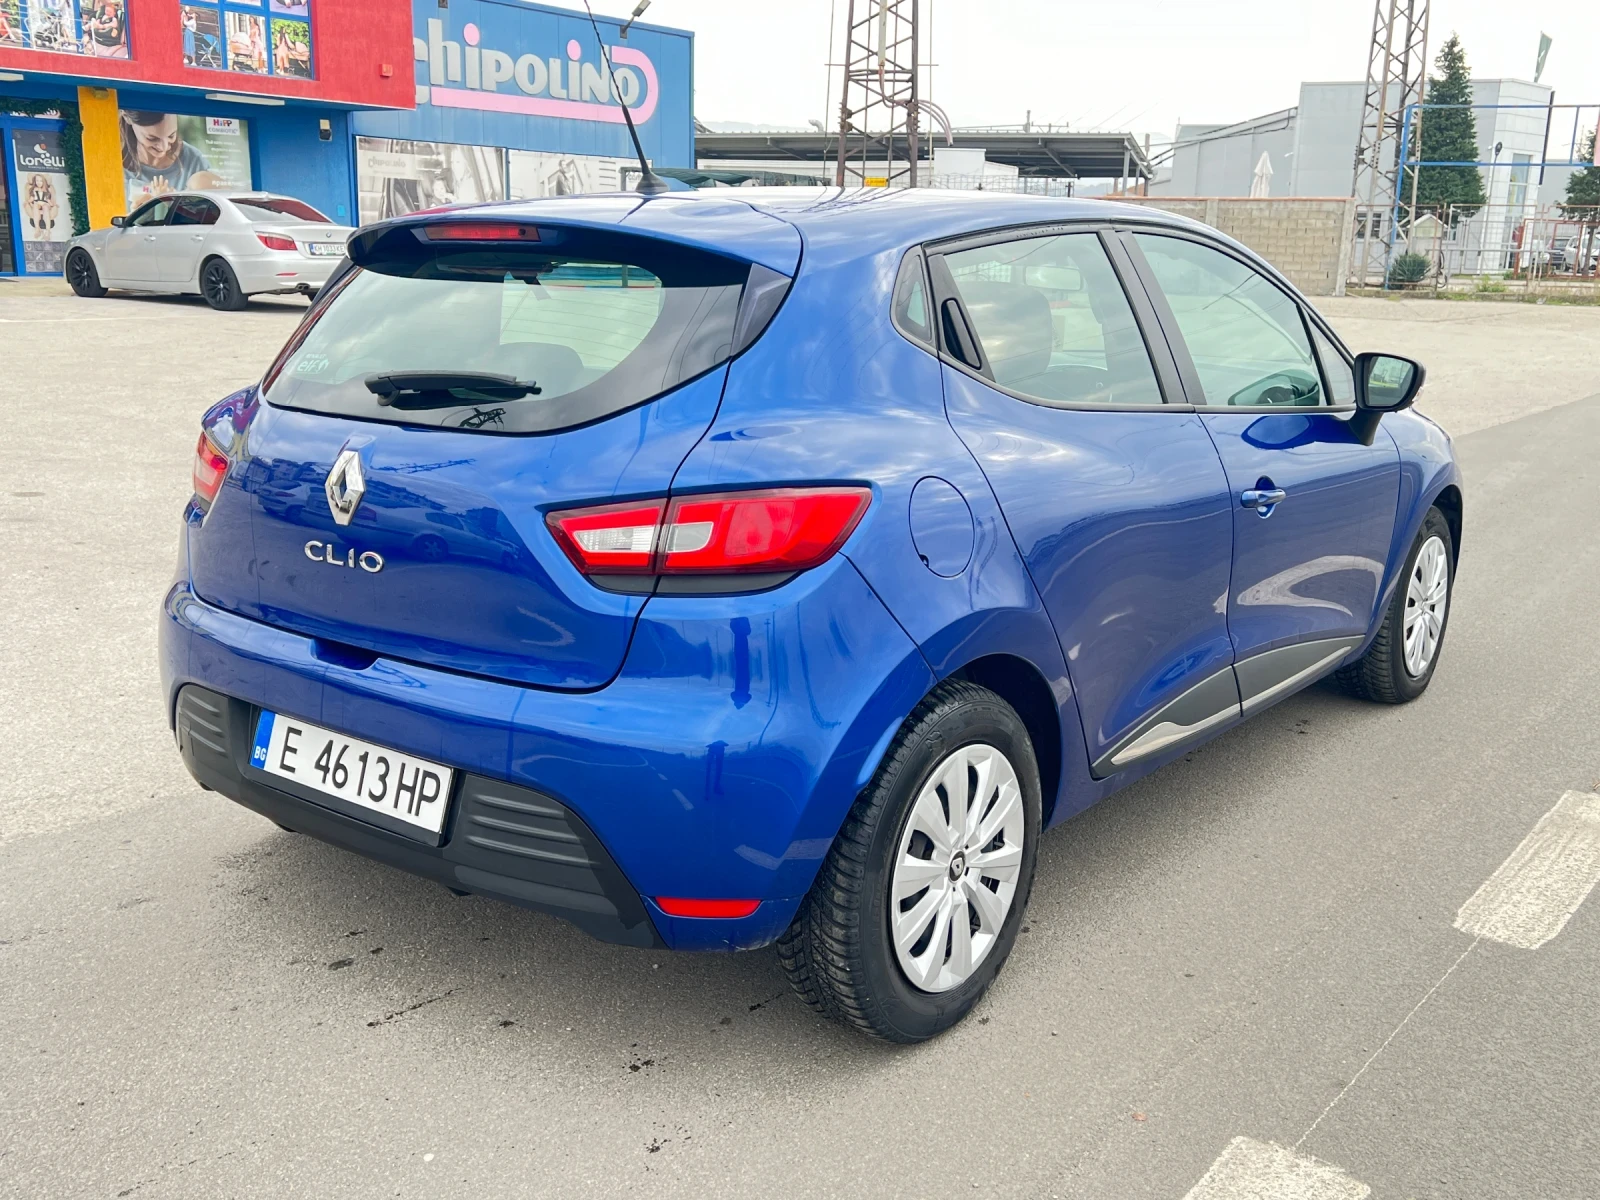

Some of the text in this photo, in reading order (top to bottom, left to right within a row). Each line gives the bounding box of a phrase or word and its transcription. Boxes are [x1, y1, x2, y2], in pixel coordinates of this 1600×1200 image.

[304, 540, 384, 573] CLIO
[254, 745, 267, 761] BG
[279, 726, 302, 774] E
